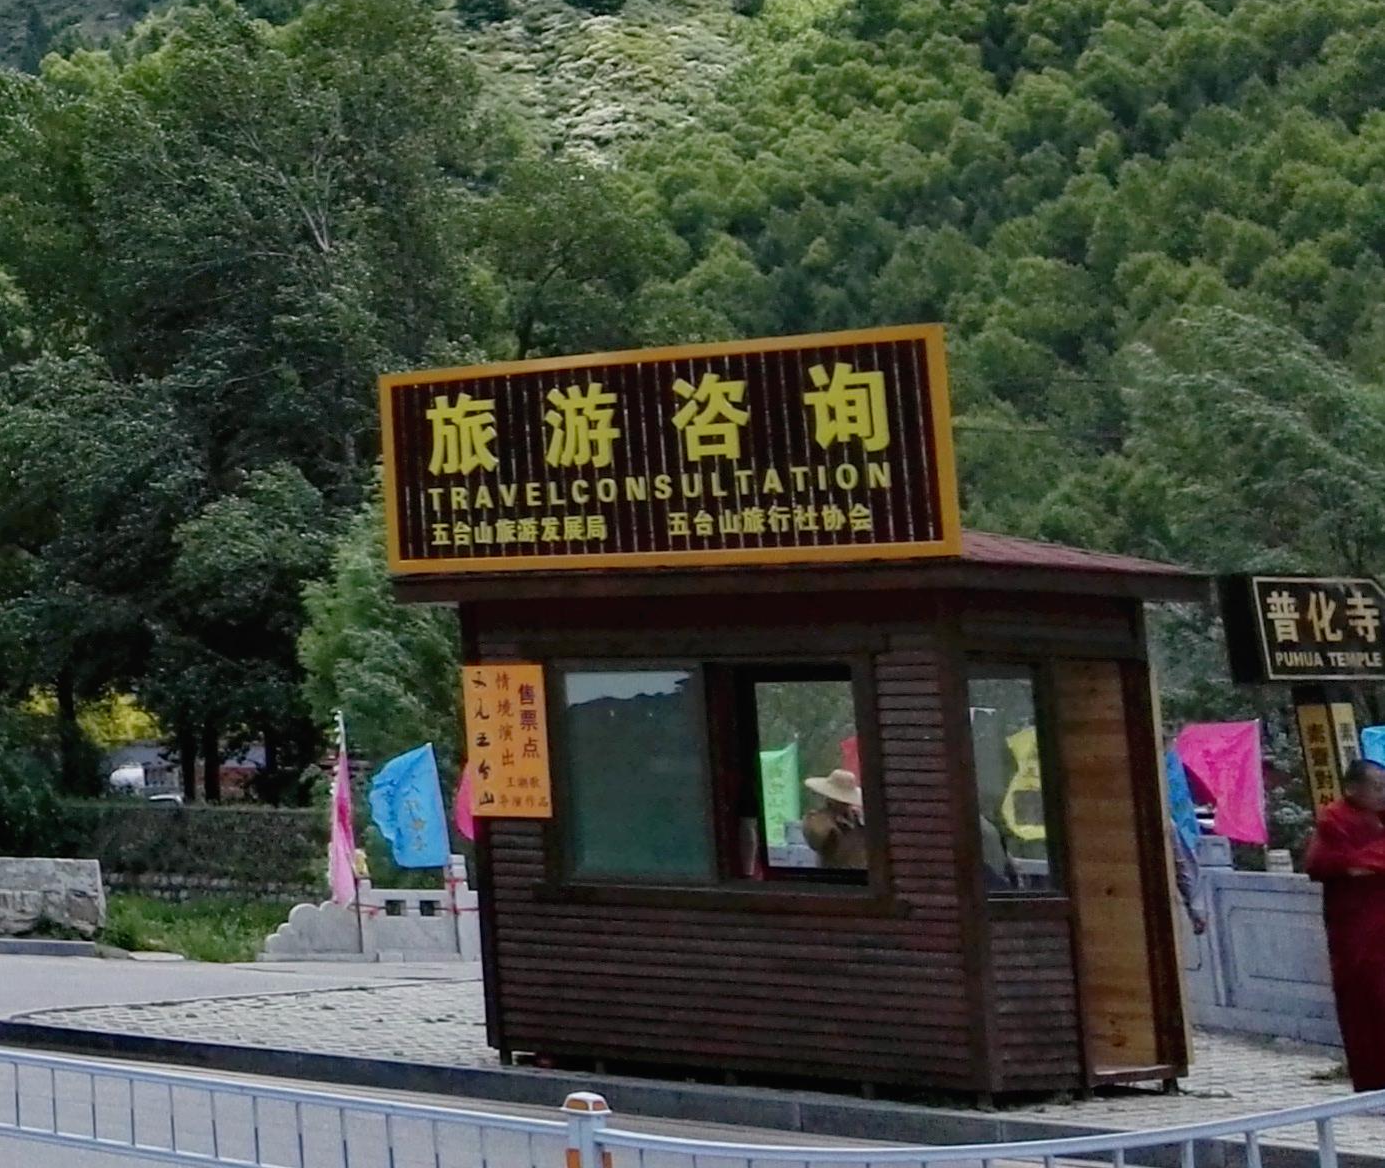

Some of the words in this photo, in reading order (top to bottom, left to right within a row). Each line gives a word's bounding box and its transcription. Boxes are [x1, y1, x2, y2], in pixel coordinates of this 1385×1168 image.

[426, 361, 891, 475] 旅游咨询
[431, 515, 608, 547] 五台山旅游发展局
[668, 503, 873, 537] 五台山旅行社协会
[1266, 590, 1381, 644] 普化寺
[1275, 651, 1324, 668] PUHUA
[1328, 651, 1382, 668] TEMPLE
[517, 683, 541, 759] 售票点
